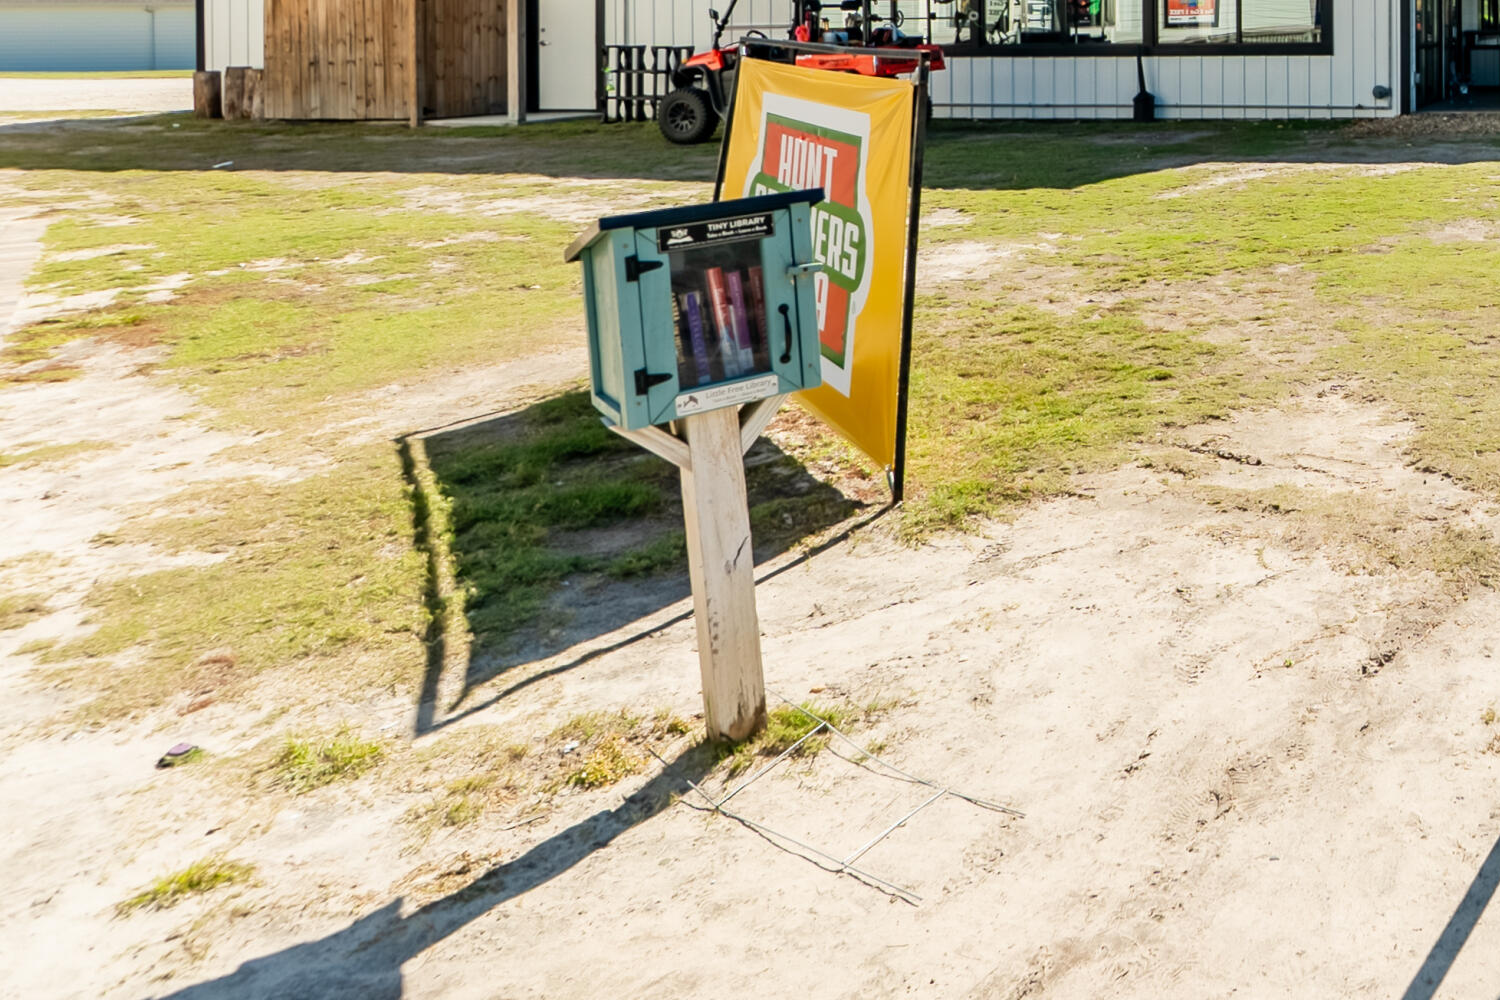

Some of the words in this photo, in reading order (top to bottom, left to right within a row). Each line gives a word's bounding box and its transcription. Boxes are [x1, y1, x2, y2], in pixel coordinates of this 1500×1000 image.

[777, 134, 838, 203] HUNT
[708, 222, 728, 232] TINY
[730, 216, 765, 228] LIBRARY
[705, 388, 726, 400] Little
[727, 384, 745, 394] Free
[745, 380, 771, 391] Library
